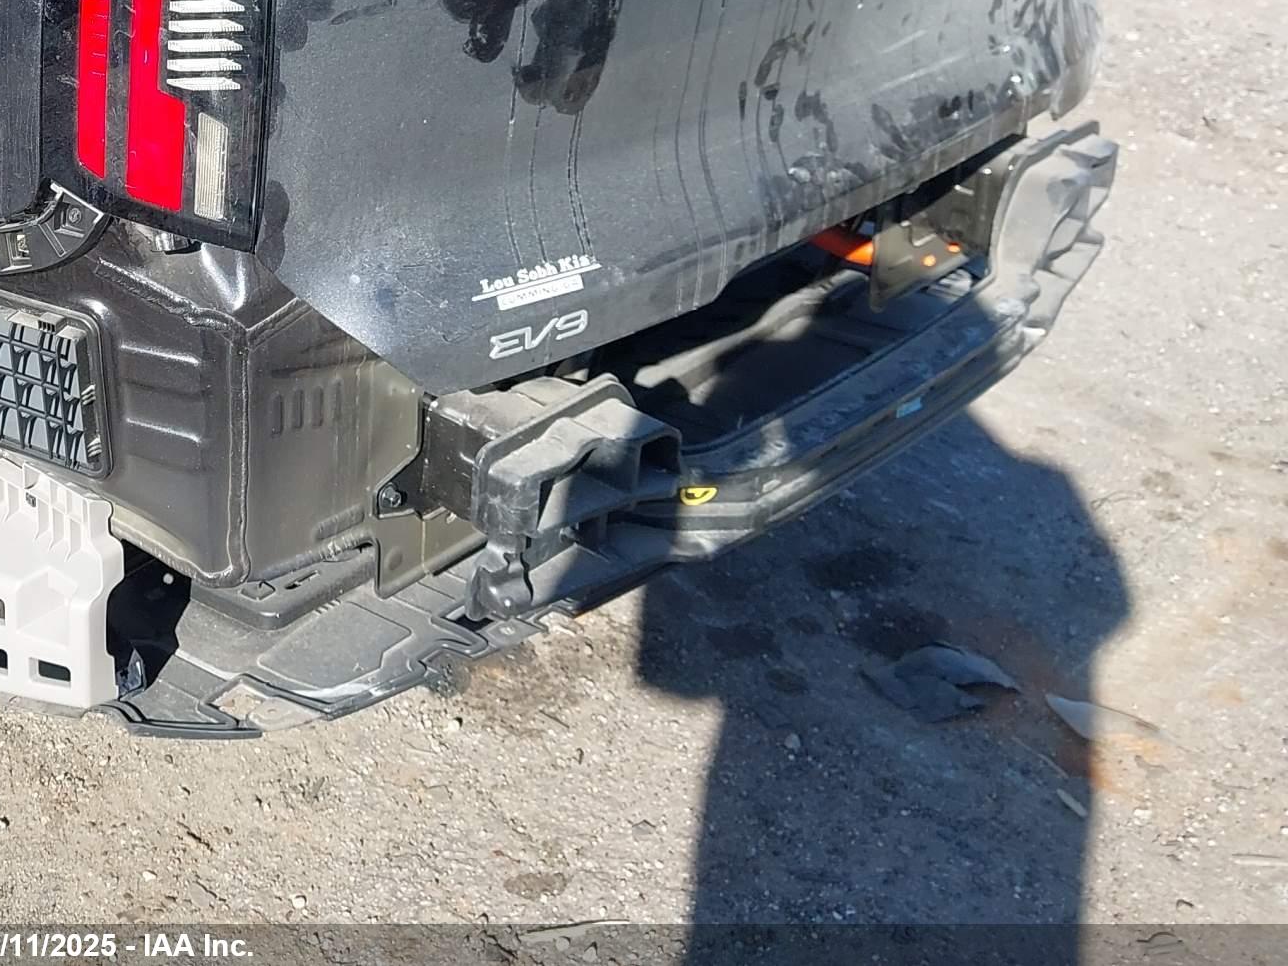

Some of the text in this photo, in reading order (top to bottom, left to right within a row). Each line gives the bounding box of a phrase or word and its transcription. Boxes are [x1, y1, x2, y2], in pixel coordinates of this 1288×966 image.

[480, 254, 591, 294] Lou Sobh Kia
[489, 309, 588, 360] EV9
